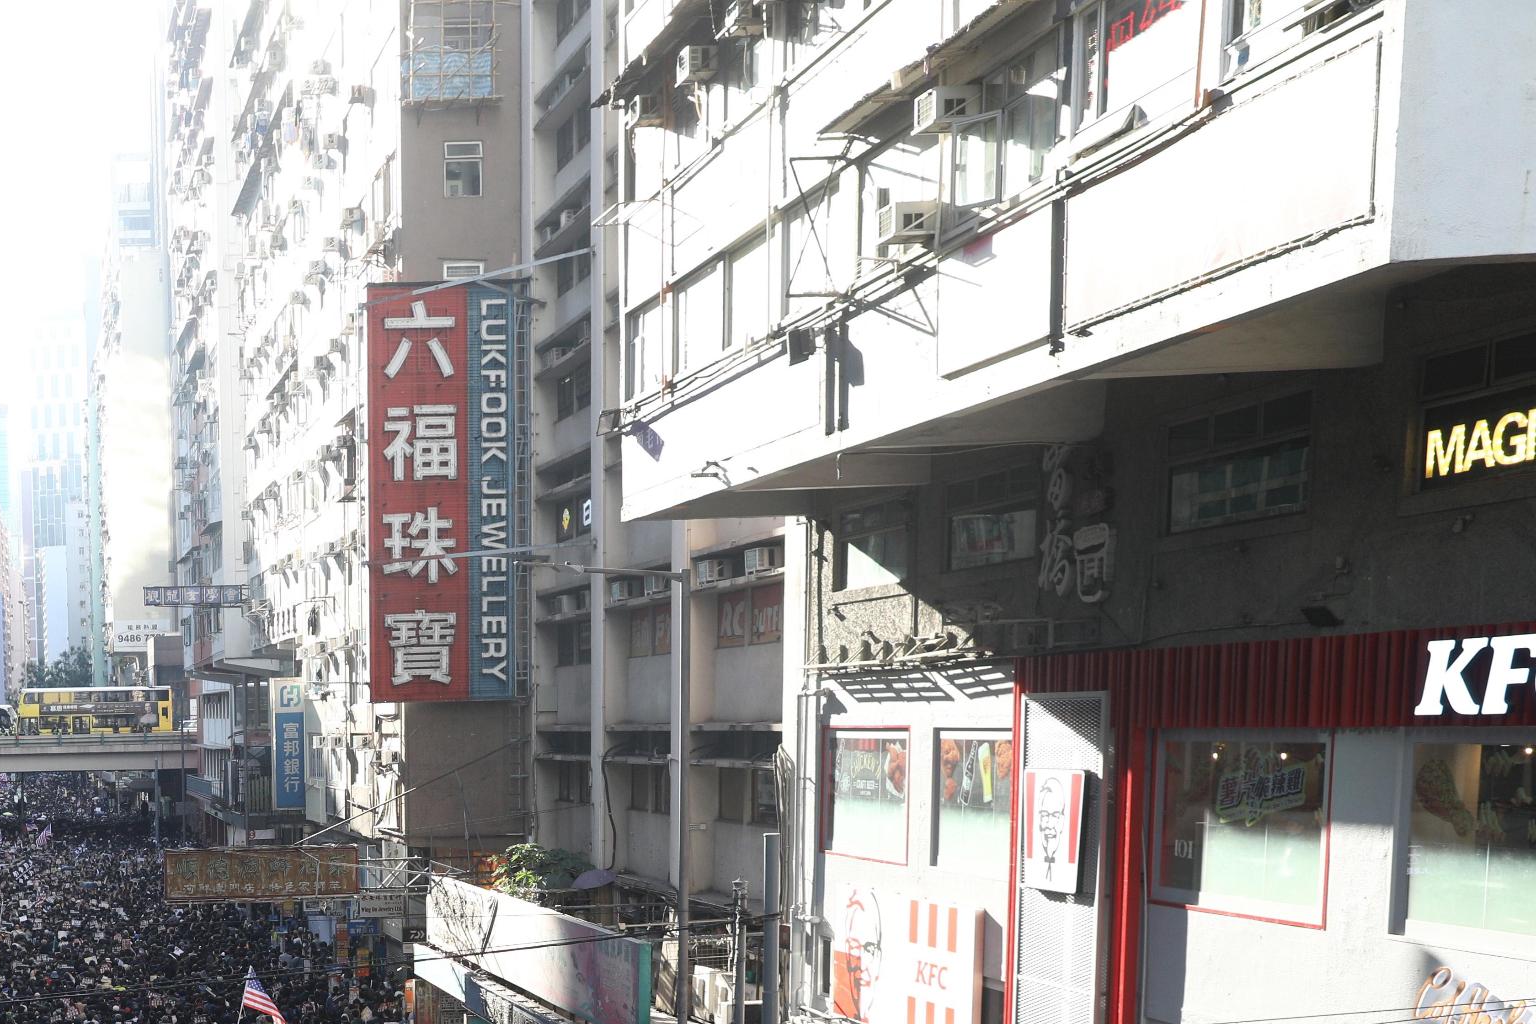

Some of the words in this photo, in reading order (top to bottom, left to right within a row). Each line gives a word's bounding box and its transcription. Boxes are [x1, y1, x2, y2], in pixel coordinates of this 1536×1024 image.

[480, 299, 507, 463] LUKFOOK
[383, 300, 457, 686] 六福珠寶
[480, 475, 507, 682] JEWELLERY
[117, 634, 142, 643] 9486
[1414, 634, 1536, 716] KF
[283, 723, 300, 793] 富邦銀行
[915, 960, 948, 990] KFC
